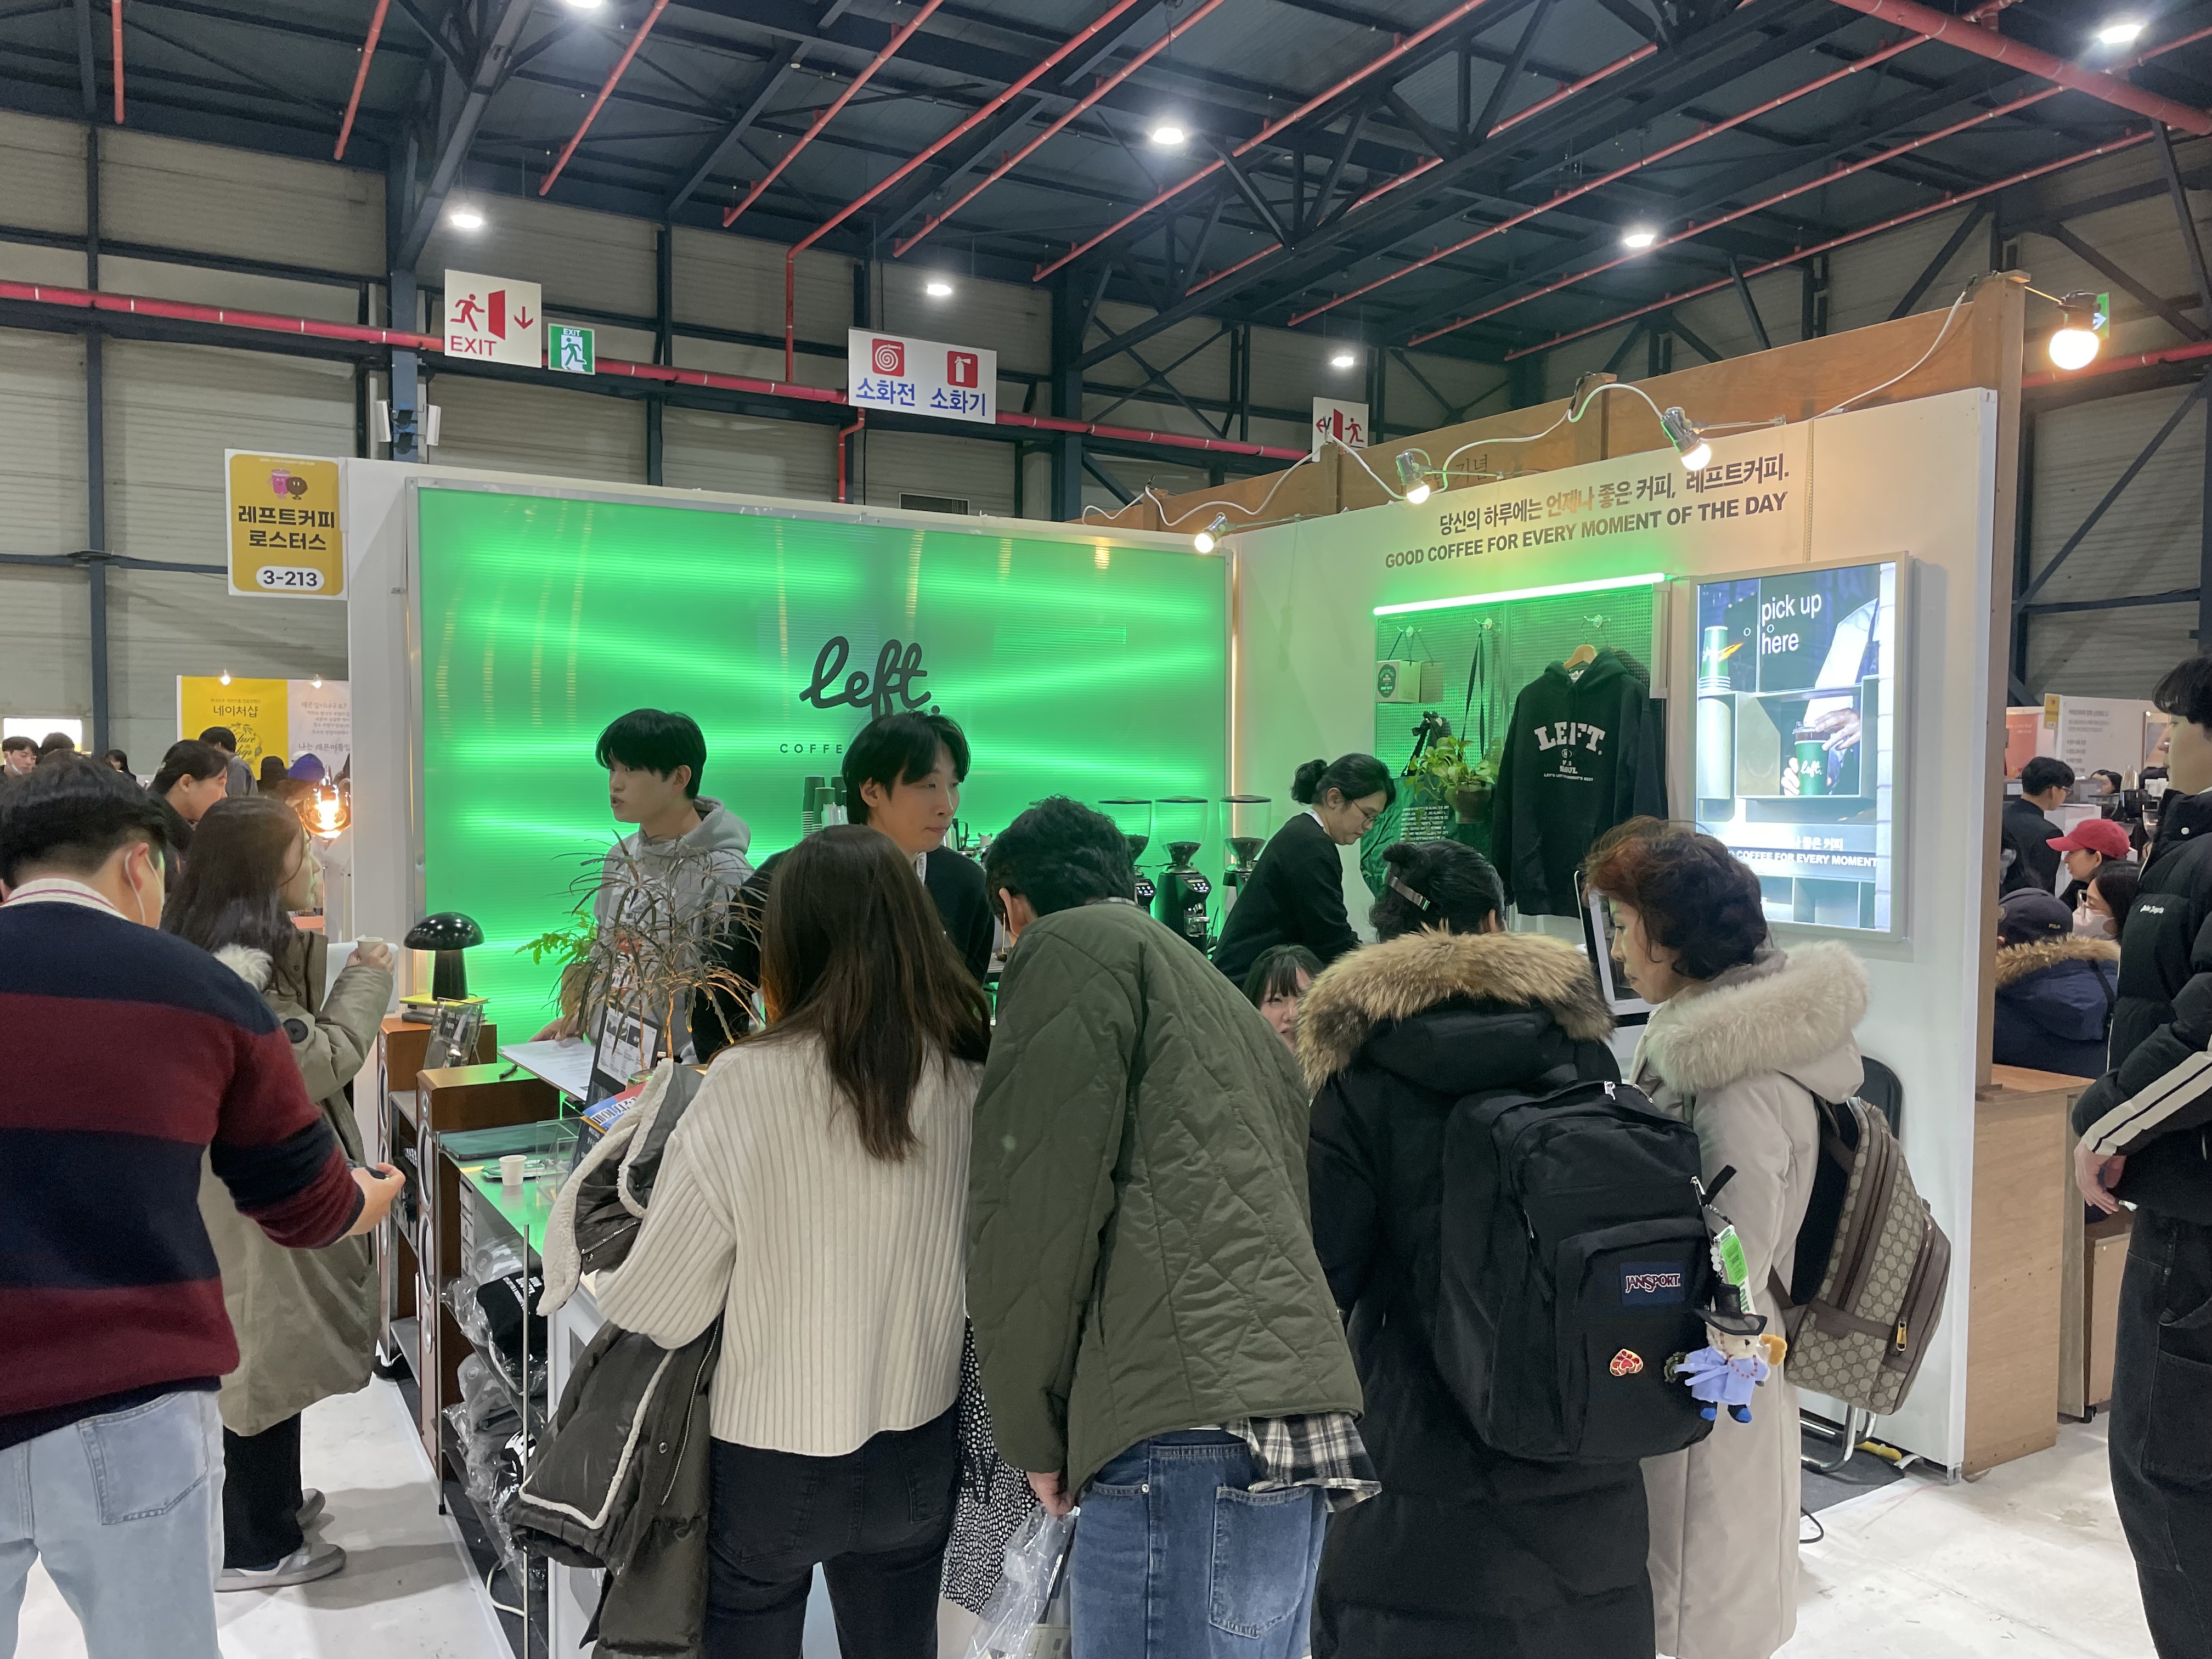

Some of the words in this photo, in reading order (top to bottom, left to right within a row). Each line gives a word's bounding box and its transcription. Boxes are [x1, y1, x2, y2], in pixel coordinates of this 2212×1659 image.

[563, 328, 581, 336] EXIT
[450, 335, 497, 356] EXIT
[856, 377, 916, 407] 소화전
[930, 387, 986, 416] 소화기
[1440, 507, 1480, 535] 당신의
[1483, 498, 1543, 528] 하루에는
[1547, 486, 1595, 518] 언제나
[1598, 481, 1633, 509] 좋은
[1637, 472, 1677, 501] 커피,
[1686, 453, 1790, 493] 레프트커피.
[238, 505, 335, 528] 레프트커피
[1385, 549, 1424, 568] GOOD
[1427, 538, 1483, 562] COFFEE
[1487, 533, 1518, 553] FOR
[1522, 523, 1577, 548] EVERY
[1581, 510, 1662, 538] MOMENT
[1667, 505, 1693, 526] OF
[1698, 499, 1740, 521] THE
[1745, 491, 1788, 515] DAY
[249, 530, 326, 551] 로스터스
[263, 570, 318, 587] 3-213
[1761, 594, 1796, 627] pick
[1799, 593, 1822, 619] up
[1761, 631, 1799, 655] here
[213, 705, 258, 718] 네이처샵
[780, 743, 843, 754] COFFE
[1738, 850, 1772, 861] COFFEE
[1774, 852, 1795, 861] FOR
[1797, 853, 1830, 865] EVERY
[1831, 855, 1878, 867] MOMENT
[1625, 1273, 1681, 1293] JANSPORT
